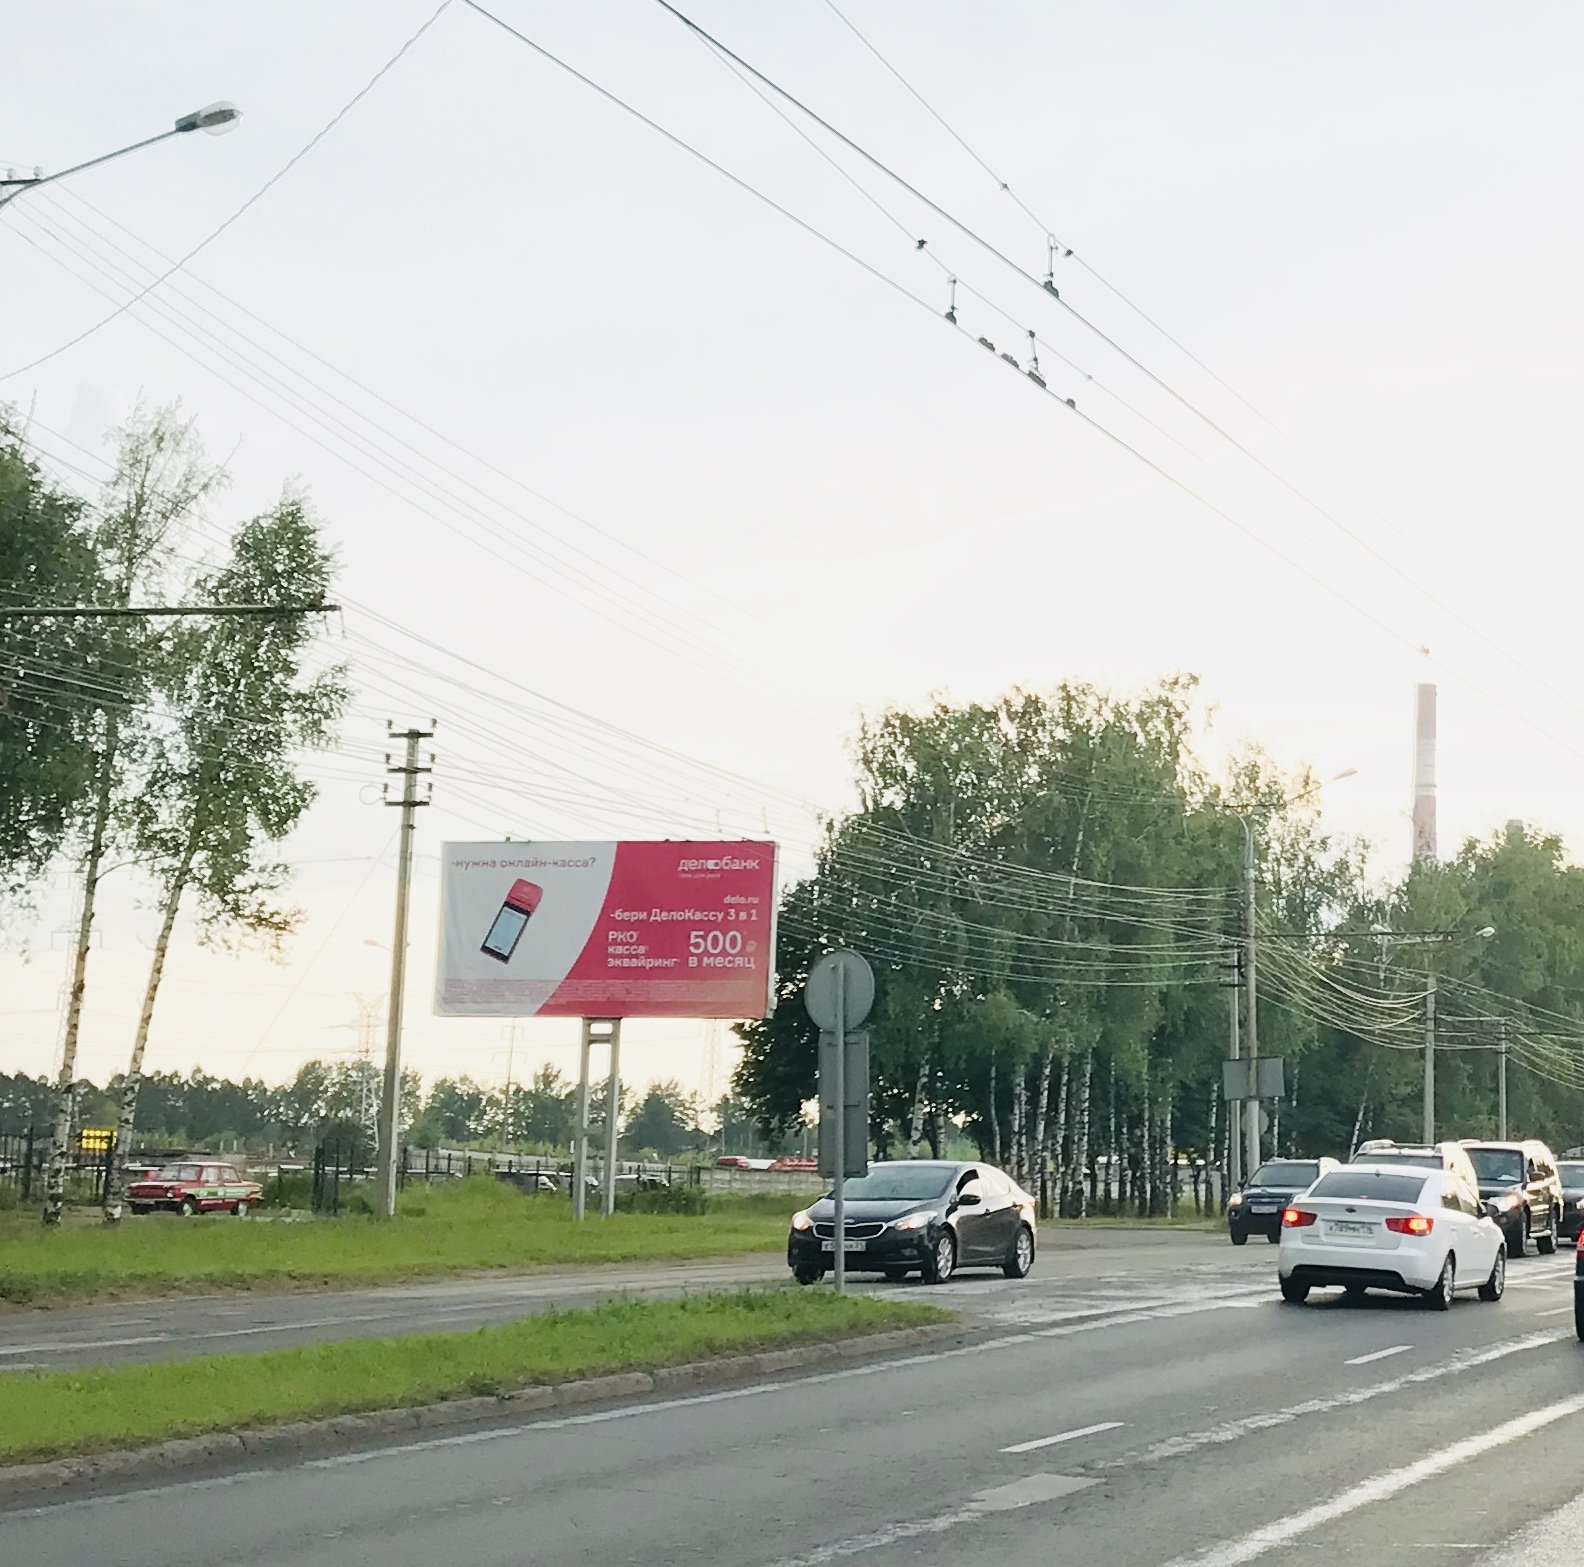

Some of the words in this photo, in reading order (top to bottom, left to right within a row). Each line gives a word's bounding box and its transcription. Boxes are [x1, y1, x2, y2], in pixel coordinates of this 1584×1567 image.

[499, 856, 597, 869] онлайн-касса?
[649, 908, 724, 923] ДелоКассу
[727, 908, 736, 921] 3
[749, 908, 758, 921] 1
[688, 930, 743, 954] 500
[688, 956, 698, 968] в
[702, 956, 756, 970] месяц
